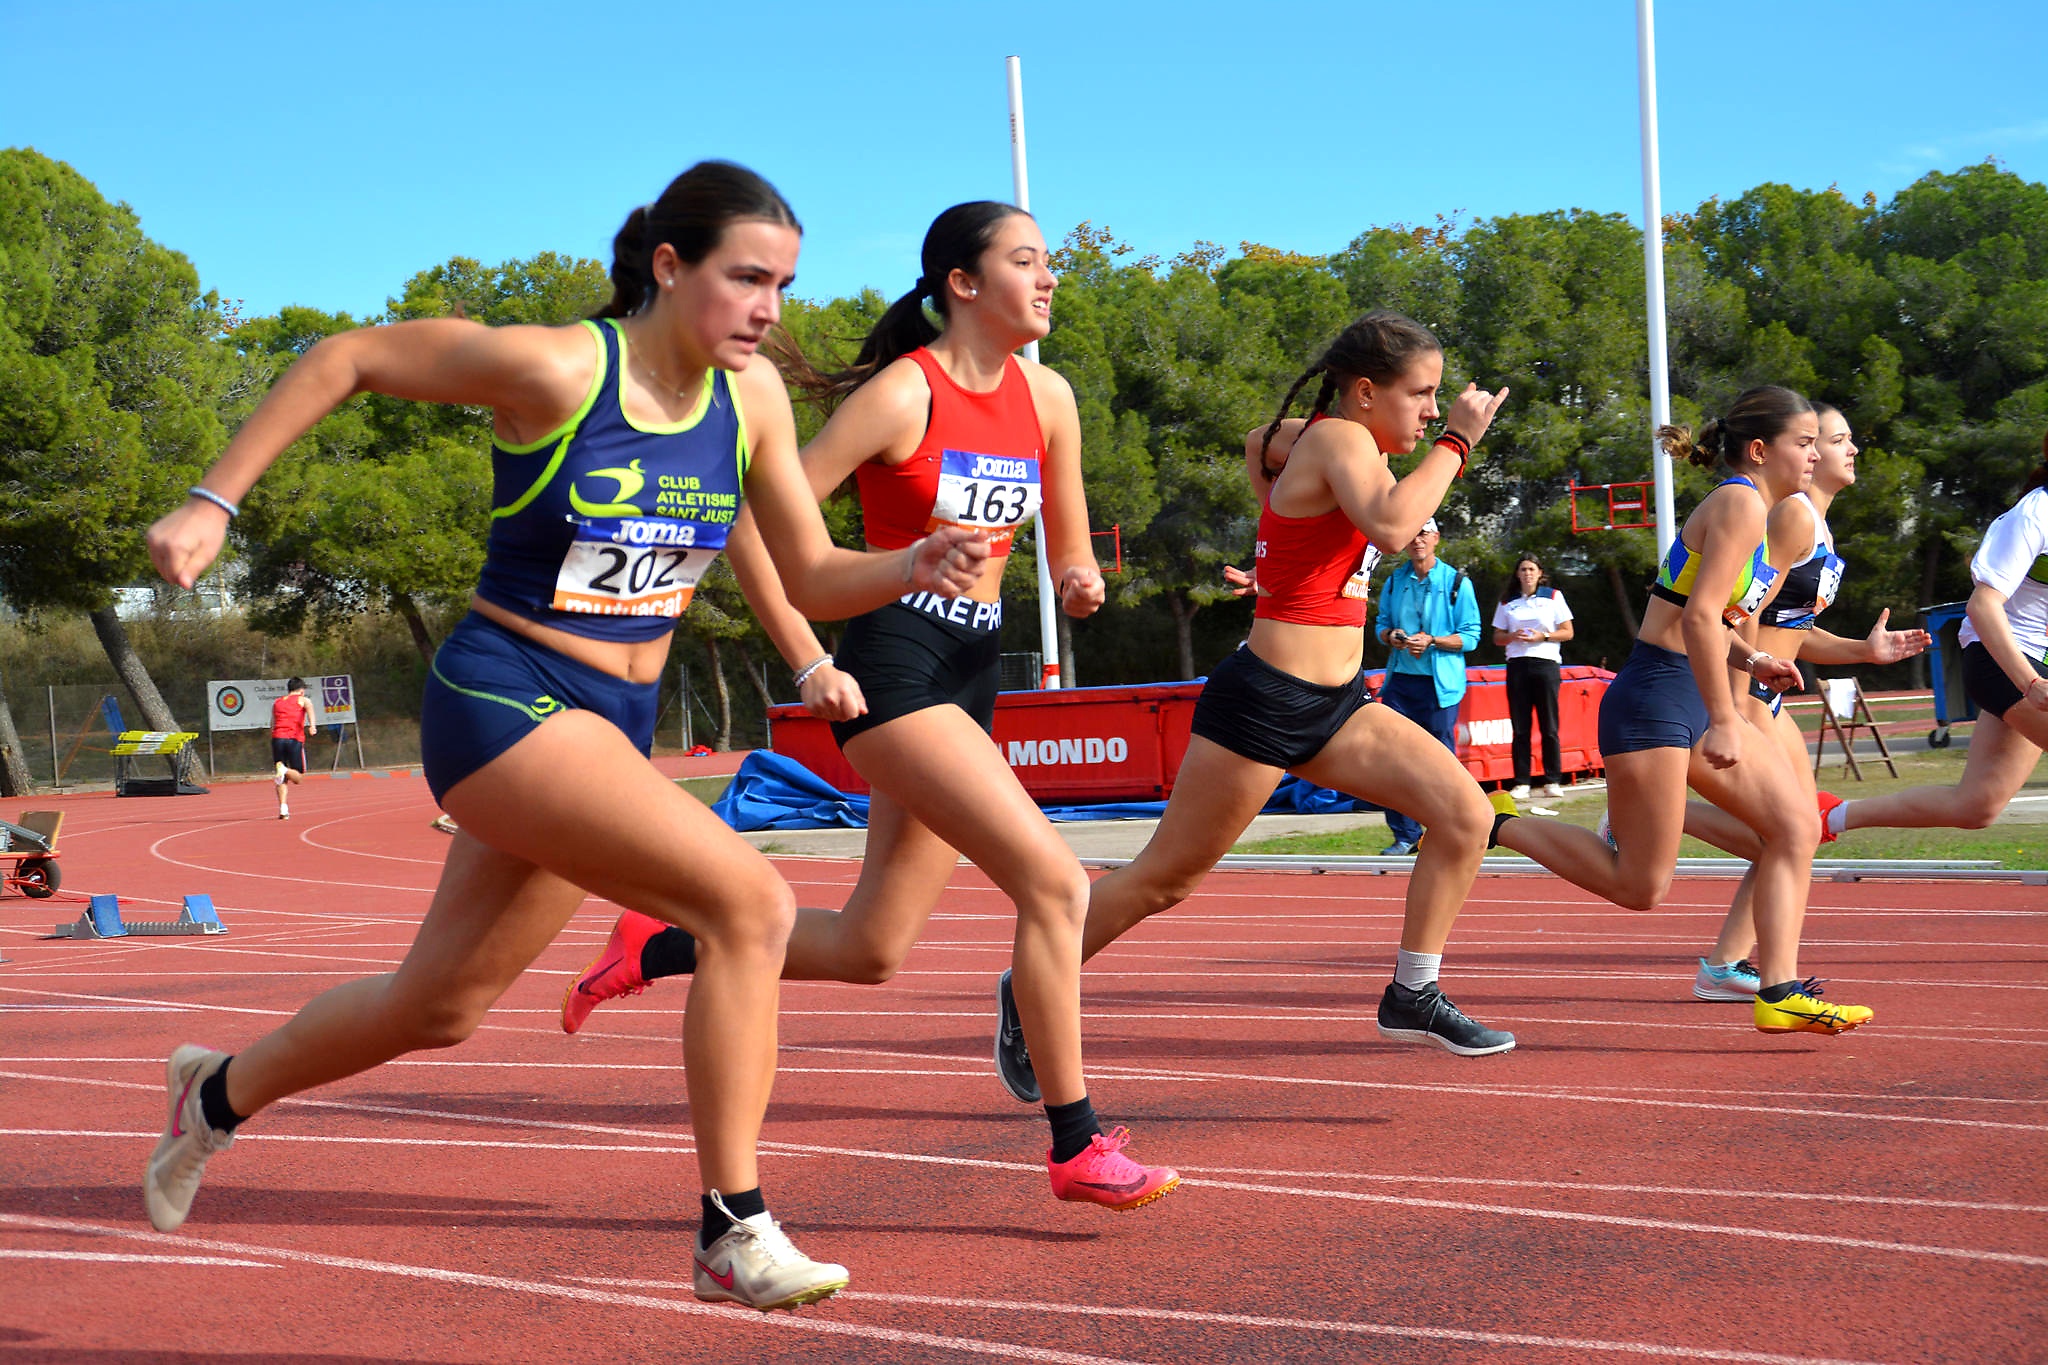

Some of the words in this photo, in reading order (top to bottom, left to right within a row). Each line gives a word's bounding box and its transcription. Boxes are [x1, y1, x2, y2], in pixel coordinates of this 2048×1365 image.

[658, 475, 701, 490] CLUB
[656, 491, 737, 508] ATLETISME
[656, 505, 700, 520] SANT
[701, 509, 736, 524] JUST
[958, 482, 1028, 523] 163
[588, 547, 689, 594] 202
[972, 596, 1002, 631] PR
[1008, 737, 1128, 767] MONDO
